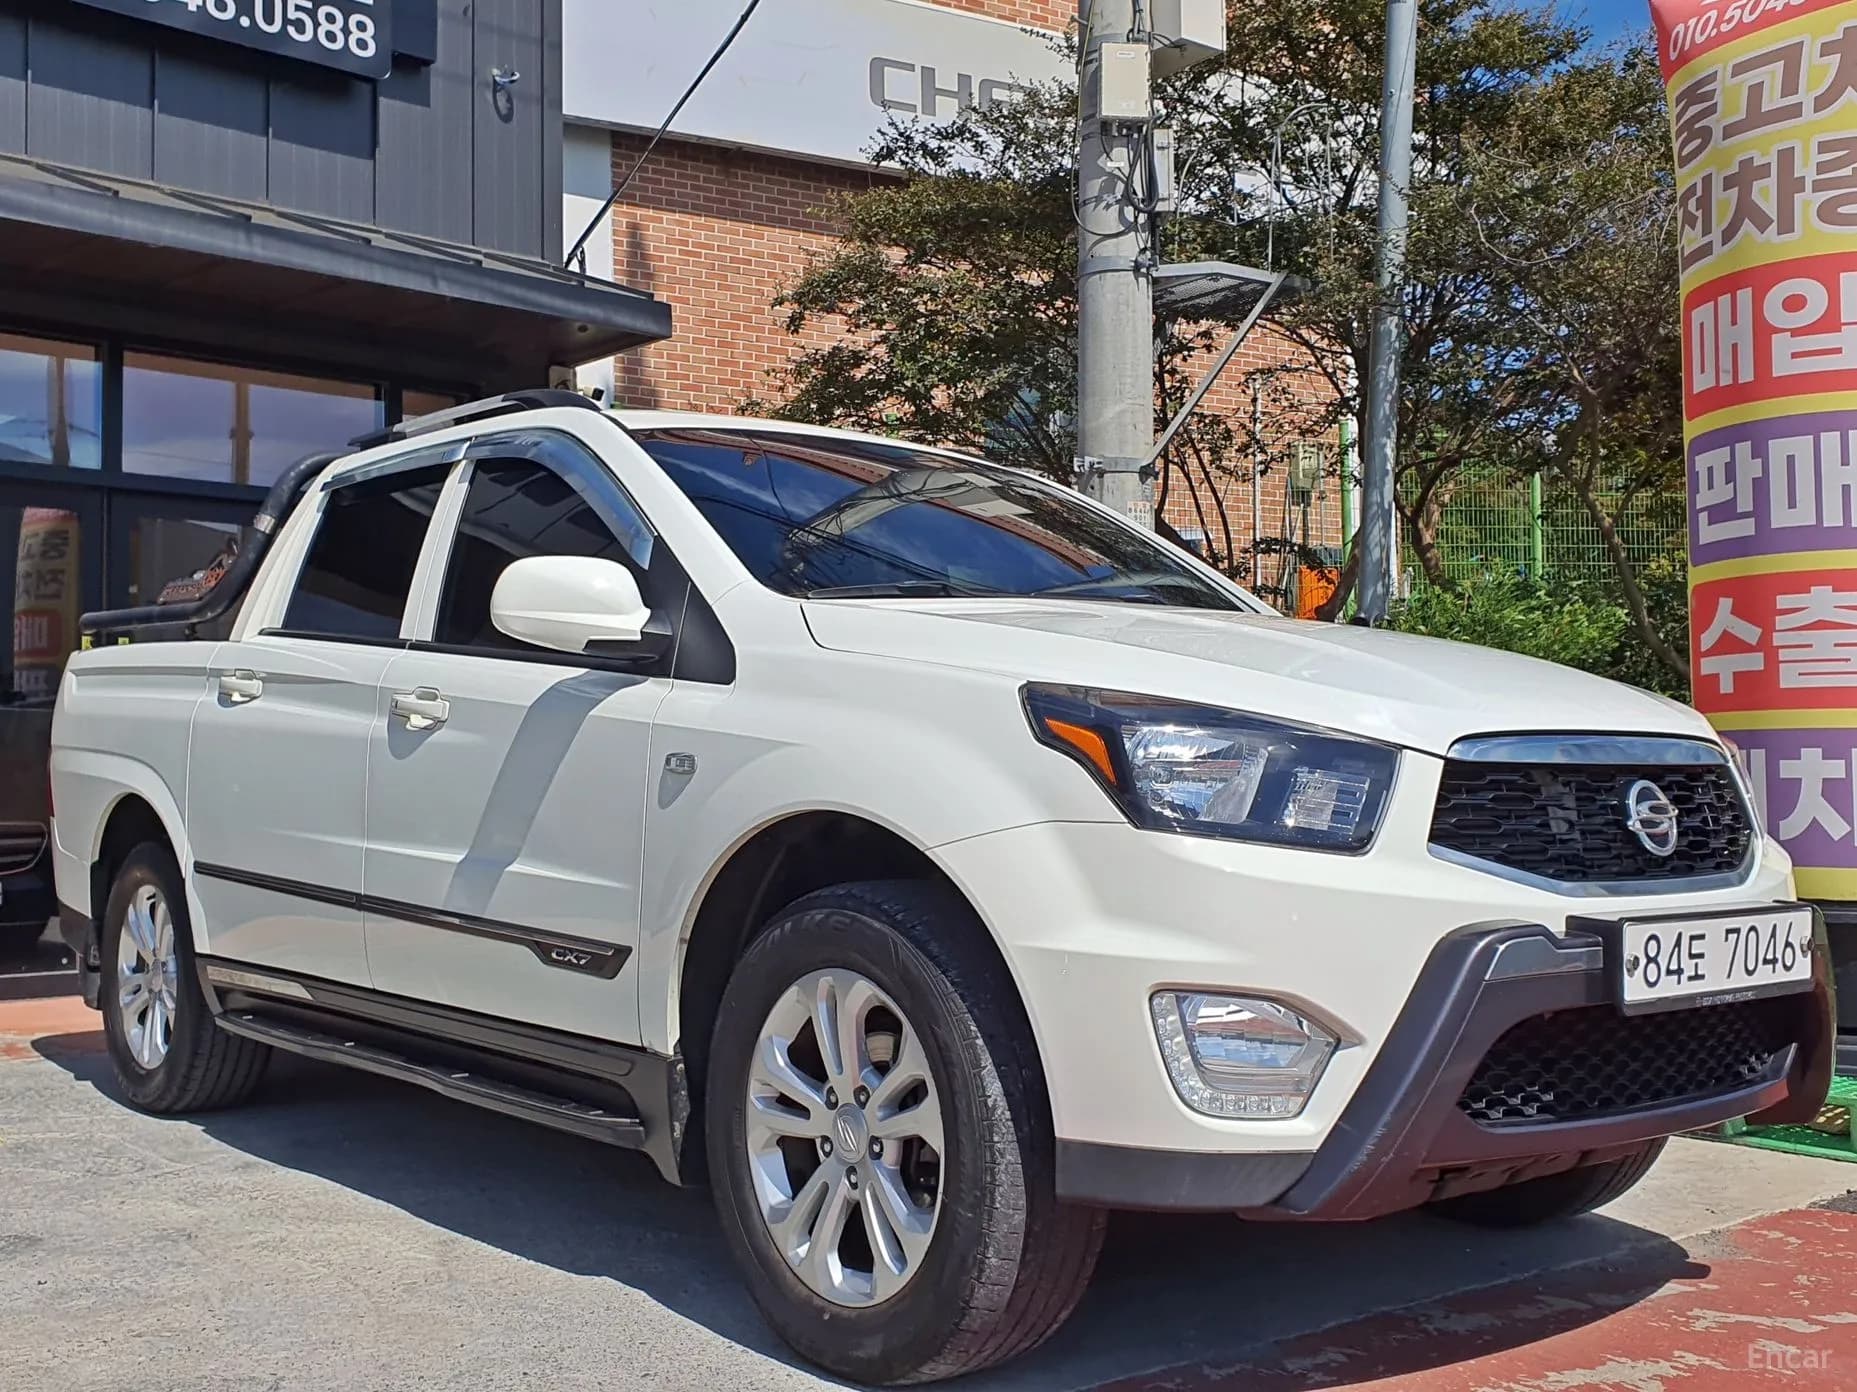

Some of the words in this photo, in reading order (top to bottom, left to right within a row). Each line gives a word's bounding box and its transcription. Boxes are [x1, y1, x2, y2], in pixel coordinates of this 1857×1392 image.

[148, 0, 377, 58] .0588
[1669, 0, 1802, 61] 010.50
[1692, 271, 1857, 395] 매입
[1695, 429, 1857, 545] 판매
[1700, 585, 1857, 694] 수출
[1740, 748, 1857, 847] 차
[551, 947, 592, 965] CX7
[1643, 931, 1706, 988] 84도
[1724, 921, 1796, 979] 7046
